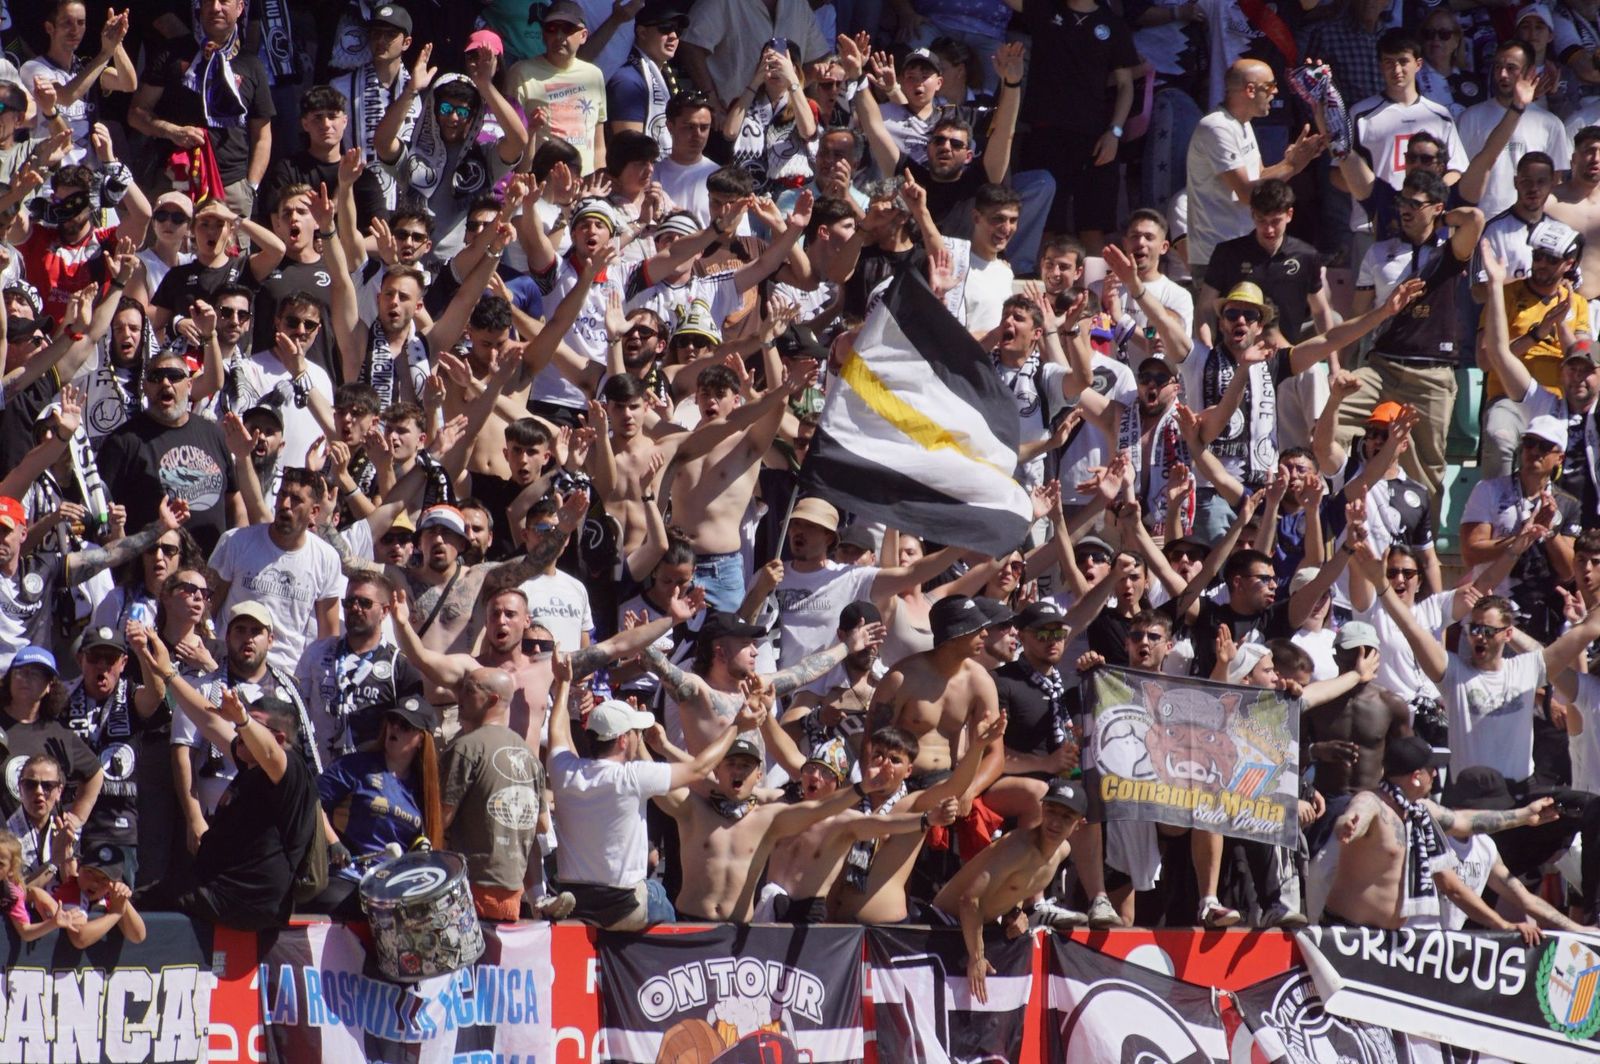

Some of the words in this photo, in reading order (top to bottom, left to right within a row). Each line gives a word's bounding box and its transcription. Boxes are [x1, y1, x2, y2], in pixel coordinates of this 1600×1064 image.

[547, 86, 587, 100] TROPICAL
[363, 686, 380, 699] QR
[1101, 774, 1215, 812] Comando
[1192, 803, 1228, 825] Solo
[259, 963, 298, 1026] LA
[638, 961, 706, 1022] ON
[705, 956, 825, 1025] TOUR
